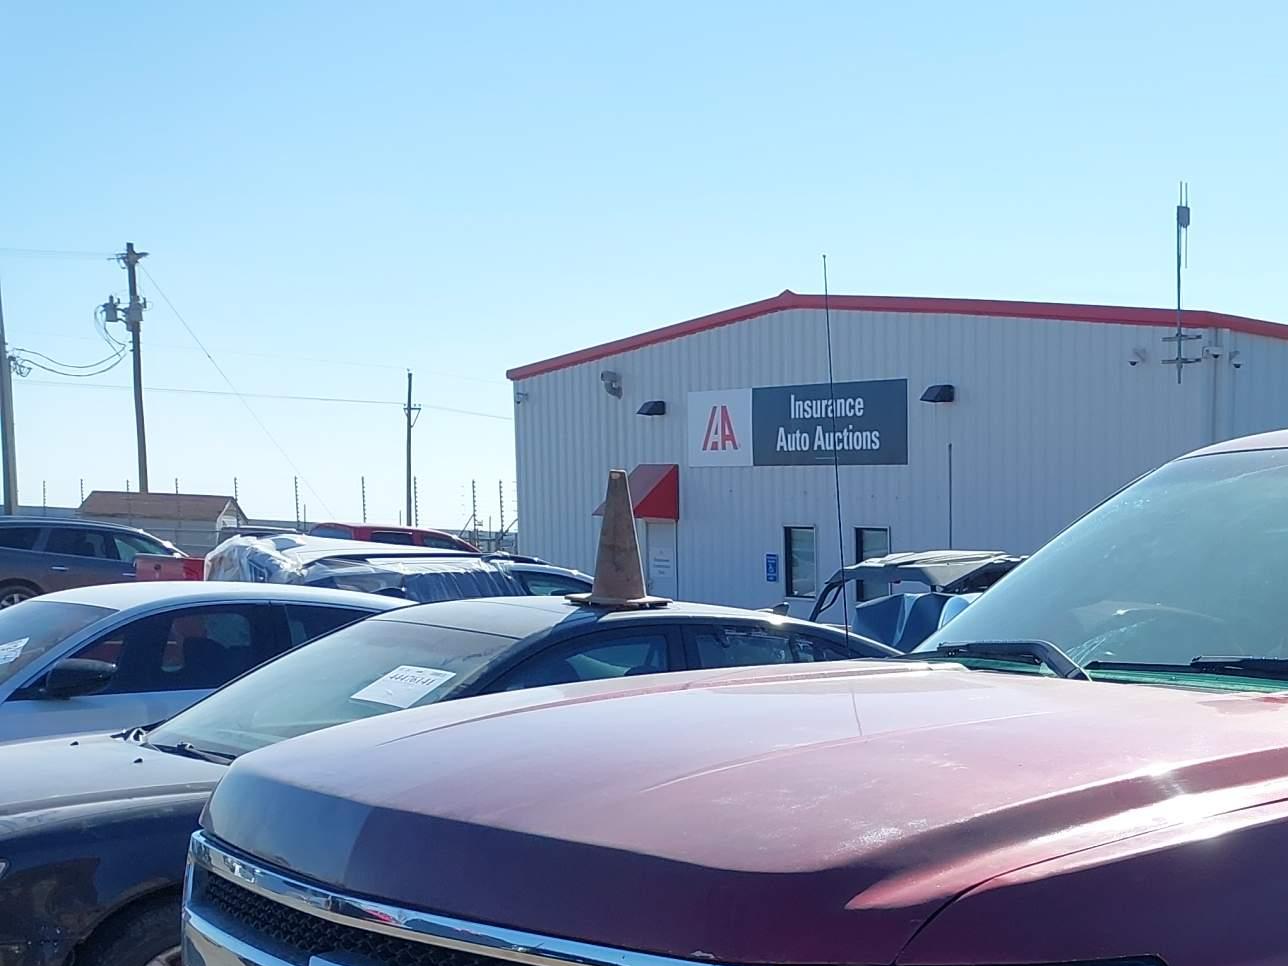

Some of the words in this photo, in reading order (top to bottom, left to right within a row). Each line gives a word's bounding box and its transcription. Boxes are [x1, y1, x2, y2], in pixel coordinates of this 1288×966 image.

[790, 395, 864, 419] Insurance
[776, 426, 810, 452] Auto
[813, 425, 880, 451] Auctions
